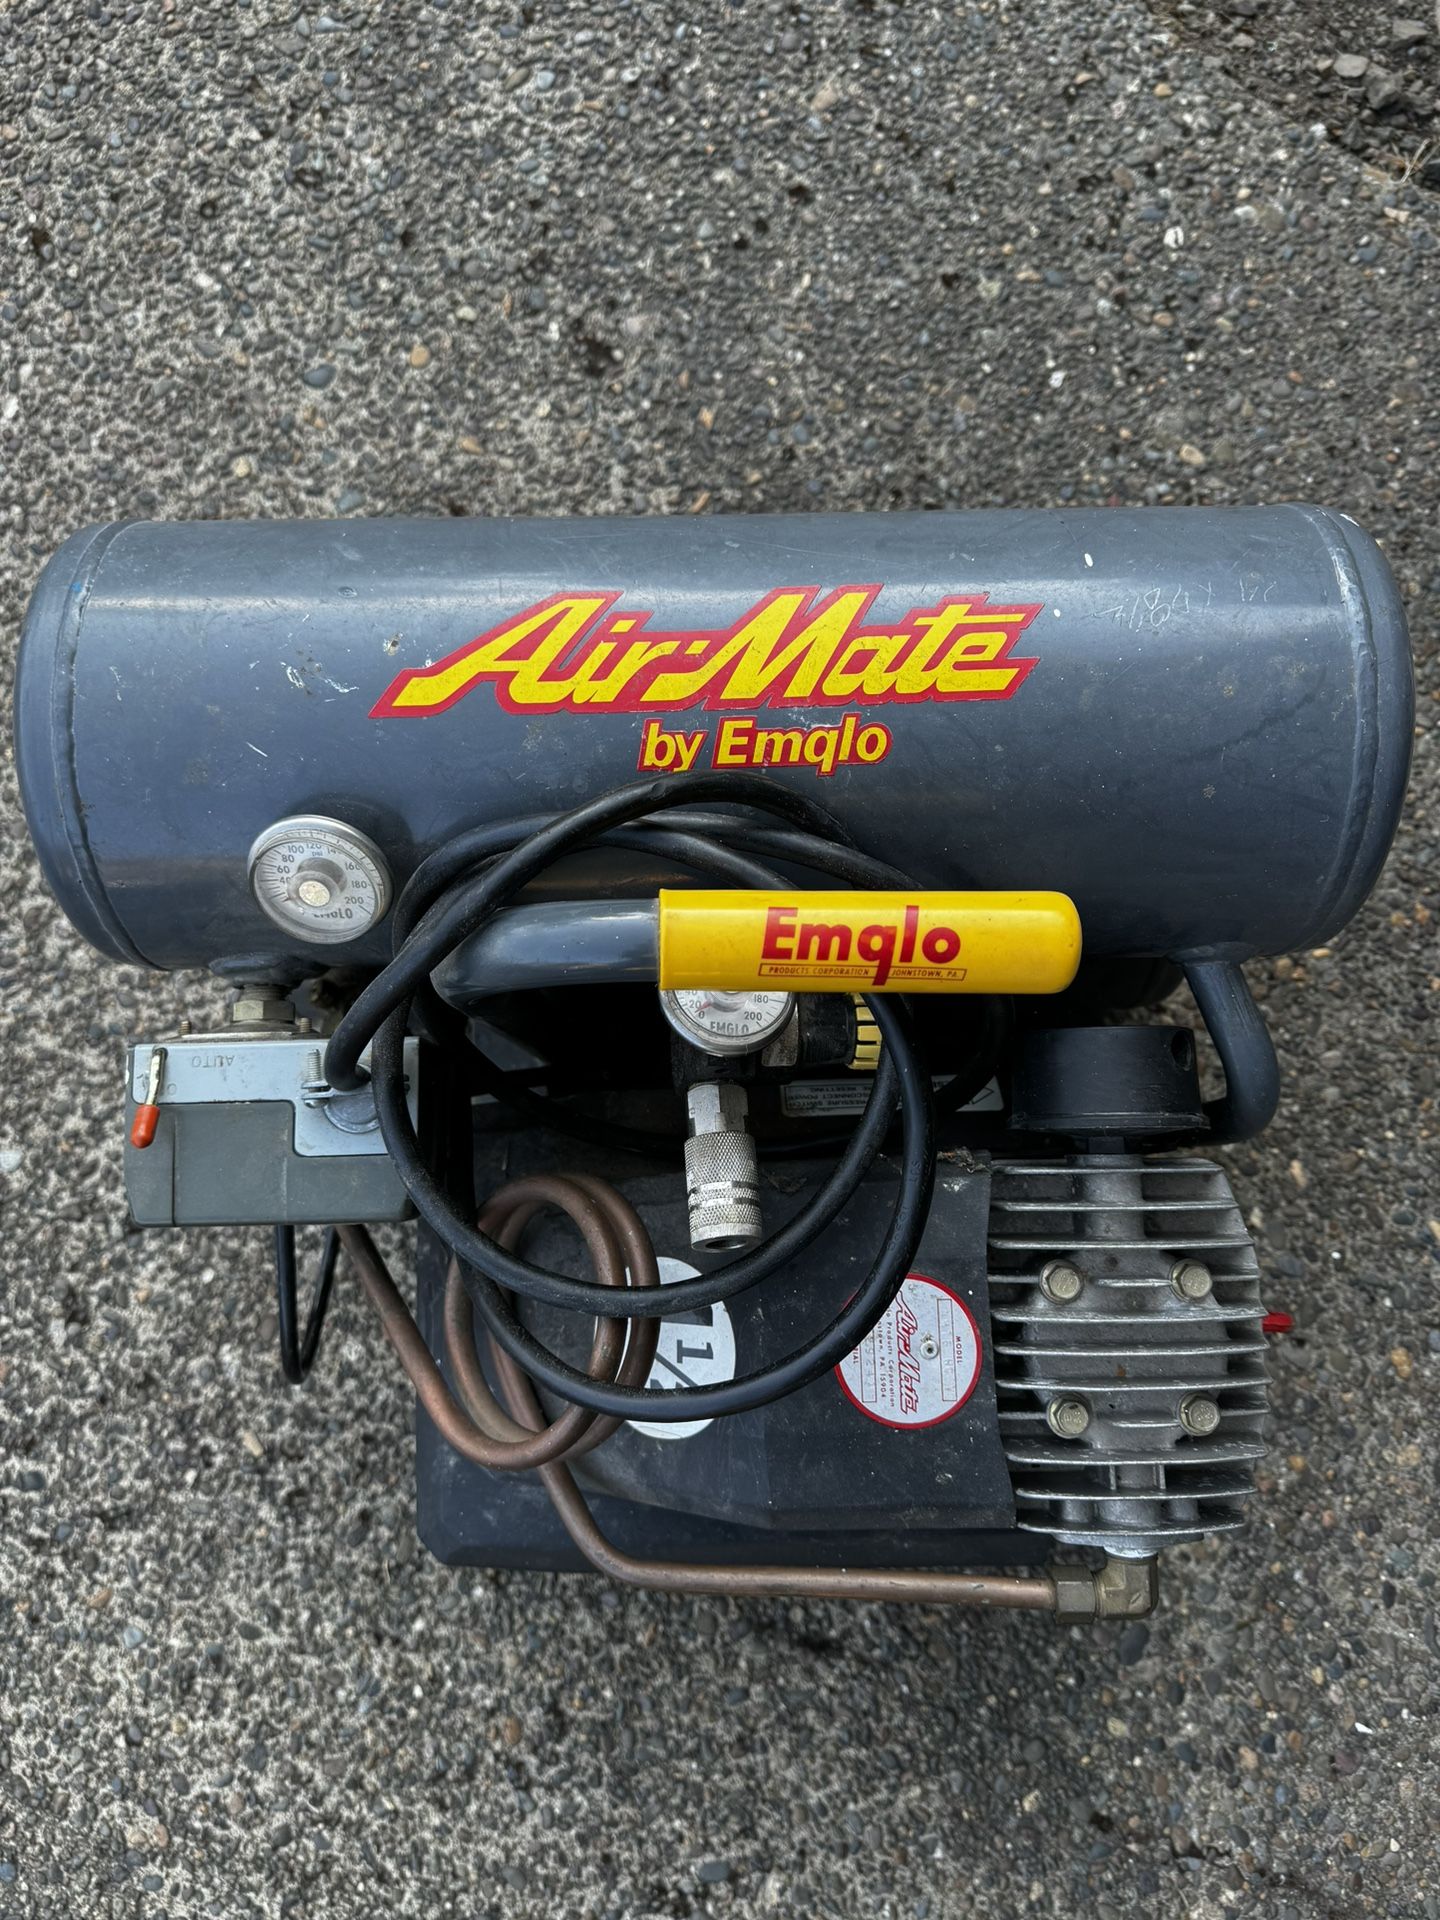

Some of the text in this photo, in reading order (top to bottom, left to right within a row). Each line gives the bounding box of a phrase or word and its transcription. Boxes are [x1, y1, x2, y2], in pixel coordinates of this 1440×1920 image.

[642, 721, 701, 771] by
[287, 845, 305, 854] 100
[281, 854, 295, 863] 80
[277, 865, 290, 874] 60
[351, 881, 367, 889] 180
[344, 896, 365, 905] 200
[768, 966, 809, 975] PRODUCTS
[812, 967, 870, 976] CORPORATION
[754, 995, 769, 1004] 180
[689, 1001, 701, 1009] 20
[698, 1011, 705, 1019] 0
[744, 1011, 762, 1021] 200
[191, 1055, 235, 1068] AUTO
[887, 1360, 895, 1407] Corporation
